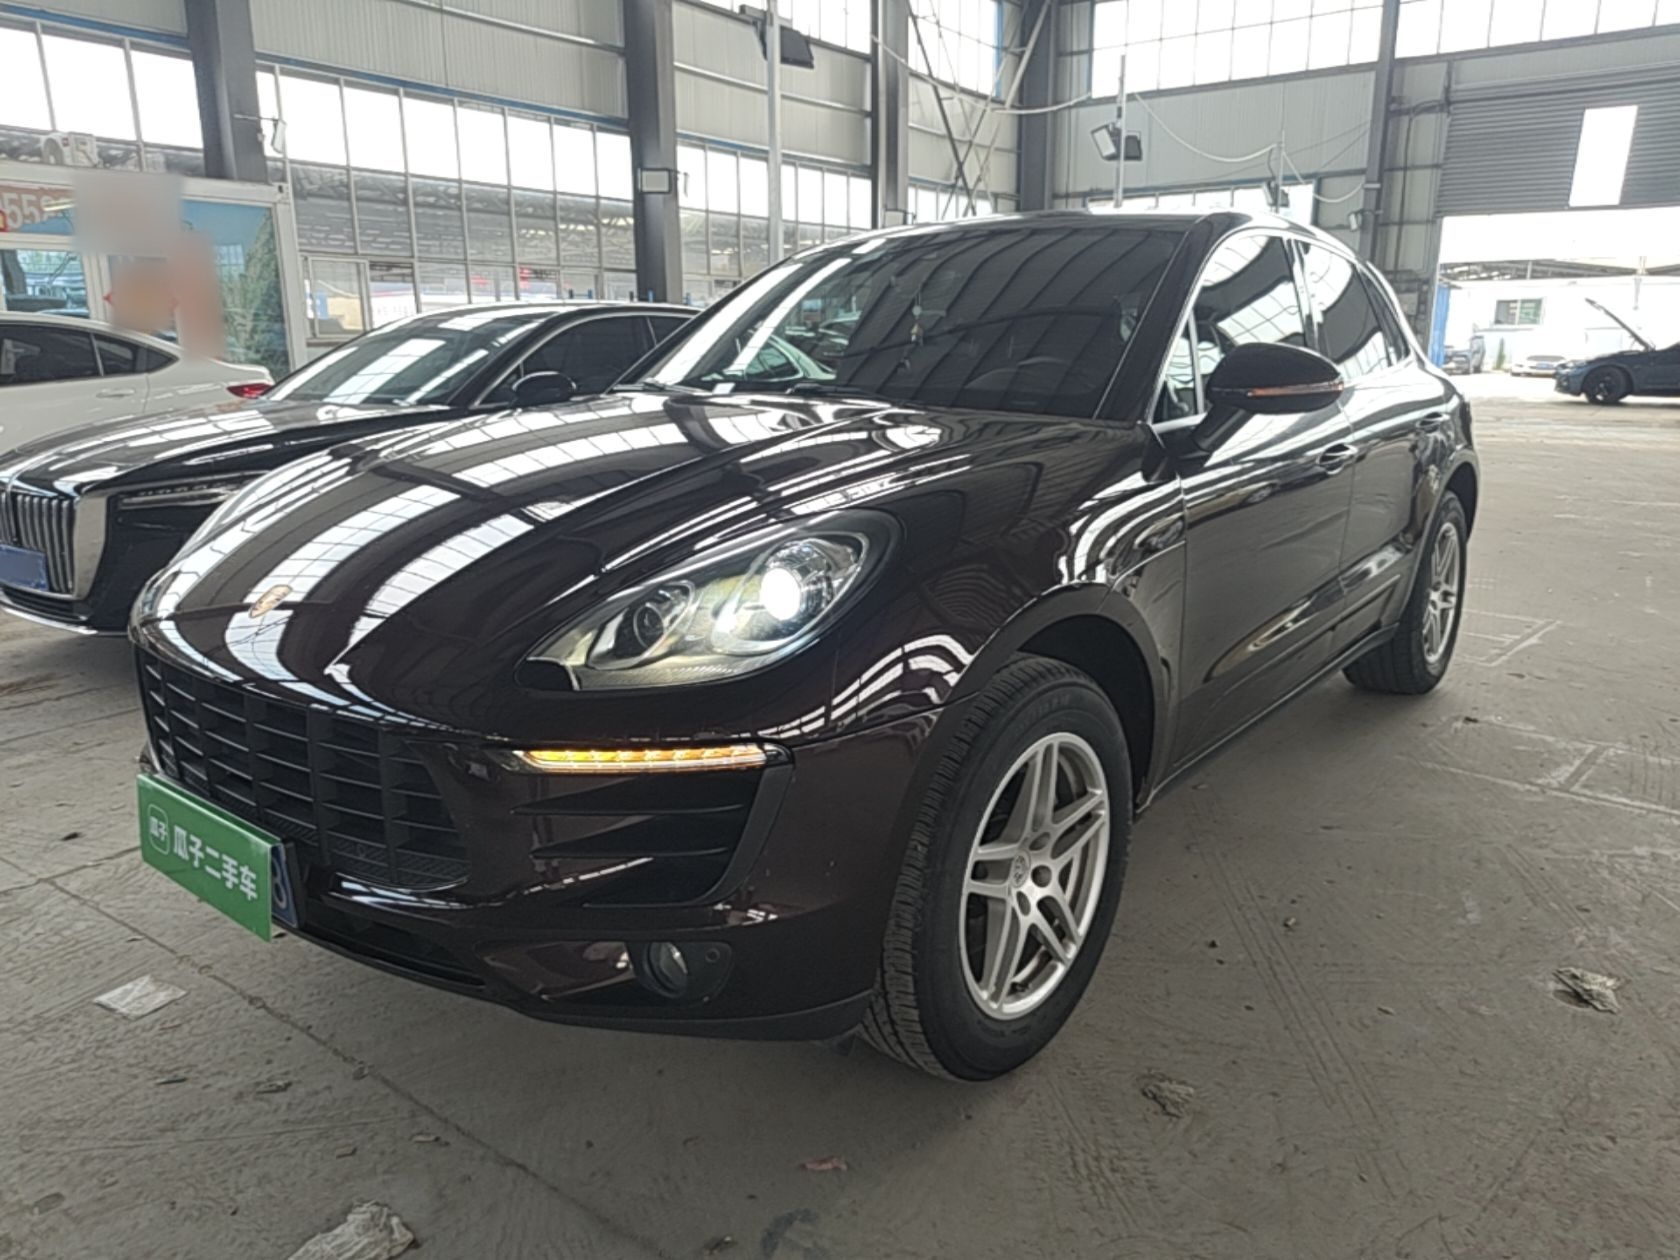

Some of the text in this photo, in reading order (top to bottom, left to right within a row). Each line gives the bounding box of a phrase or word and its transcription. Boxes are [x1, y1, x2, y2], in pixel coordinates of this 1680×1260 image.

[173, 824, 258, 901] 瓜子二手车
